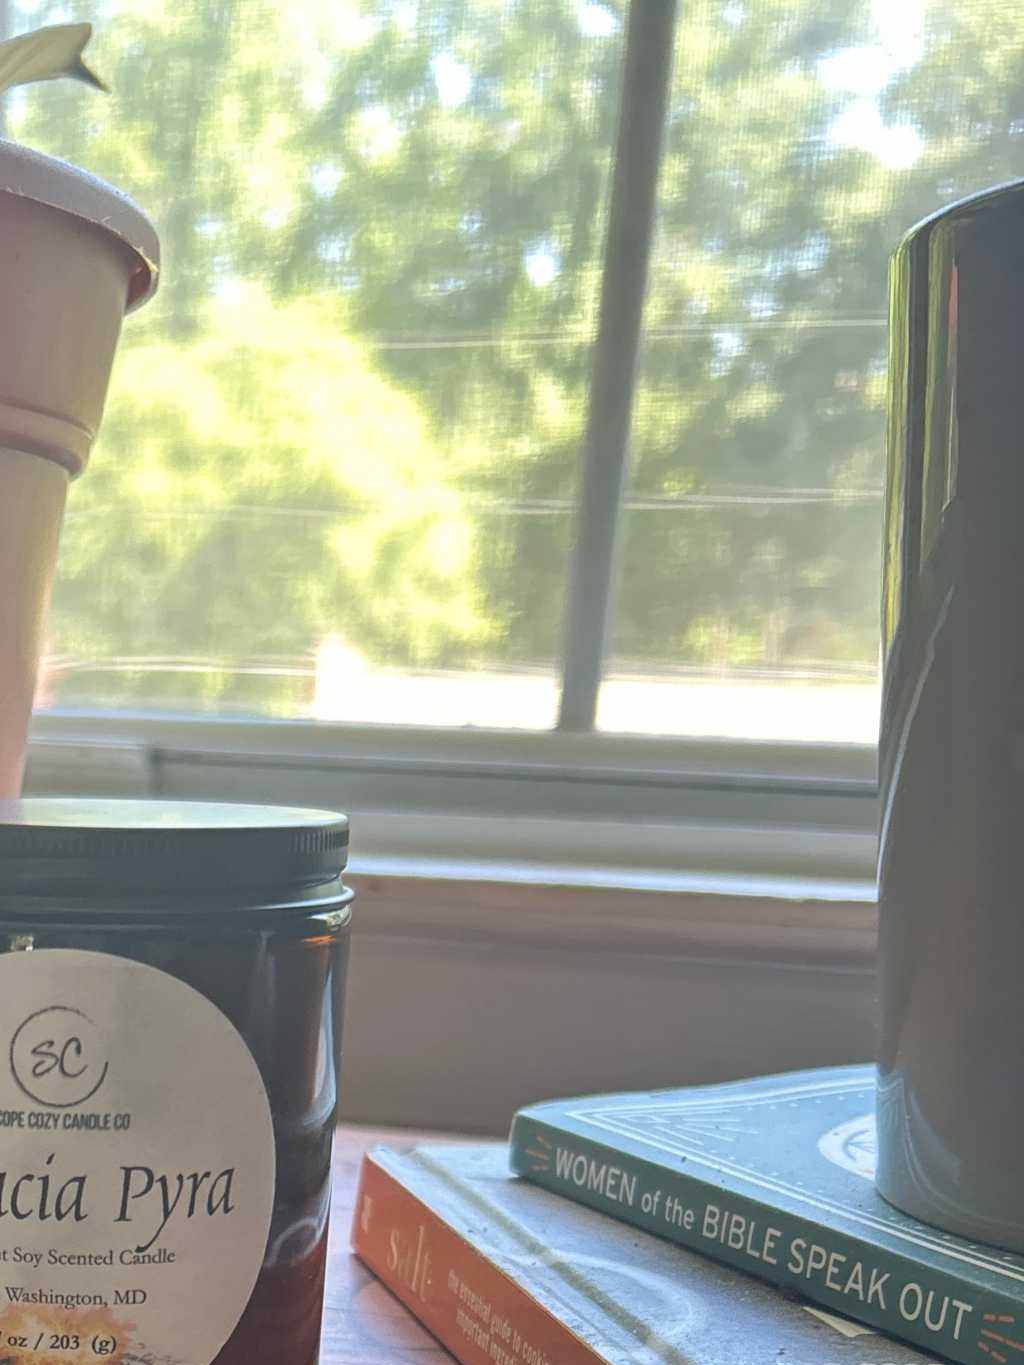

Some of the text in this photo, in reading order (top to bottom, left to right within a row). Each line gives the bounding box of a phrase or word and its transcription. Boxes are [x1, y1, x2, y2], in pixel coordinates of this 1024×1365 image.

[31, 1036, 88, 1079] SC
[28, 1111, 61, 1130] COZY
[63, 1112, 111, 1131] CANDLE
[114, 1114, 131, 1131] CO
[113, 1166, 235, 1254] Pyra
[554, 1147, 974, 1340] WOMEN of the BIBLE SPEAK OUT
[12, 1246, 44, 1268] Soy
[47, 1249, 114, 1267] Scented
[119, 1246, 177, 1266] Candle
[5, 1286, 109, 1310] Washington,
[113, 1290, 147, 1306] MD
[7, 1335, 29, 1348] oz
[33, 1332, 45, 1351] /
[49, 1334, 81, 1351] 203
[91, 1335, 118, 1355] (g)
[512, 1329, 522, 1354] to
